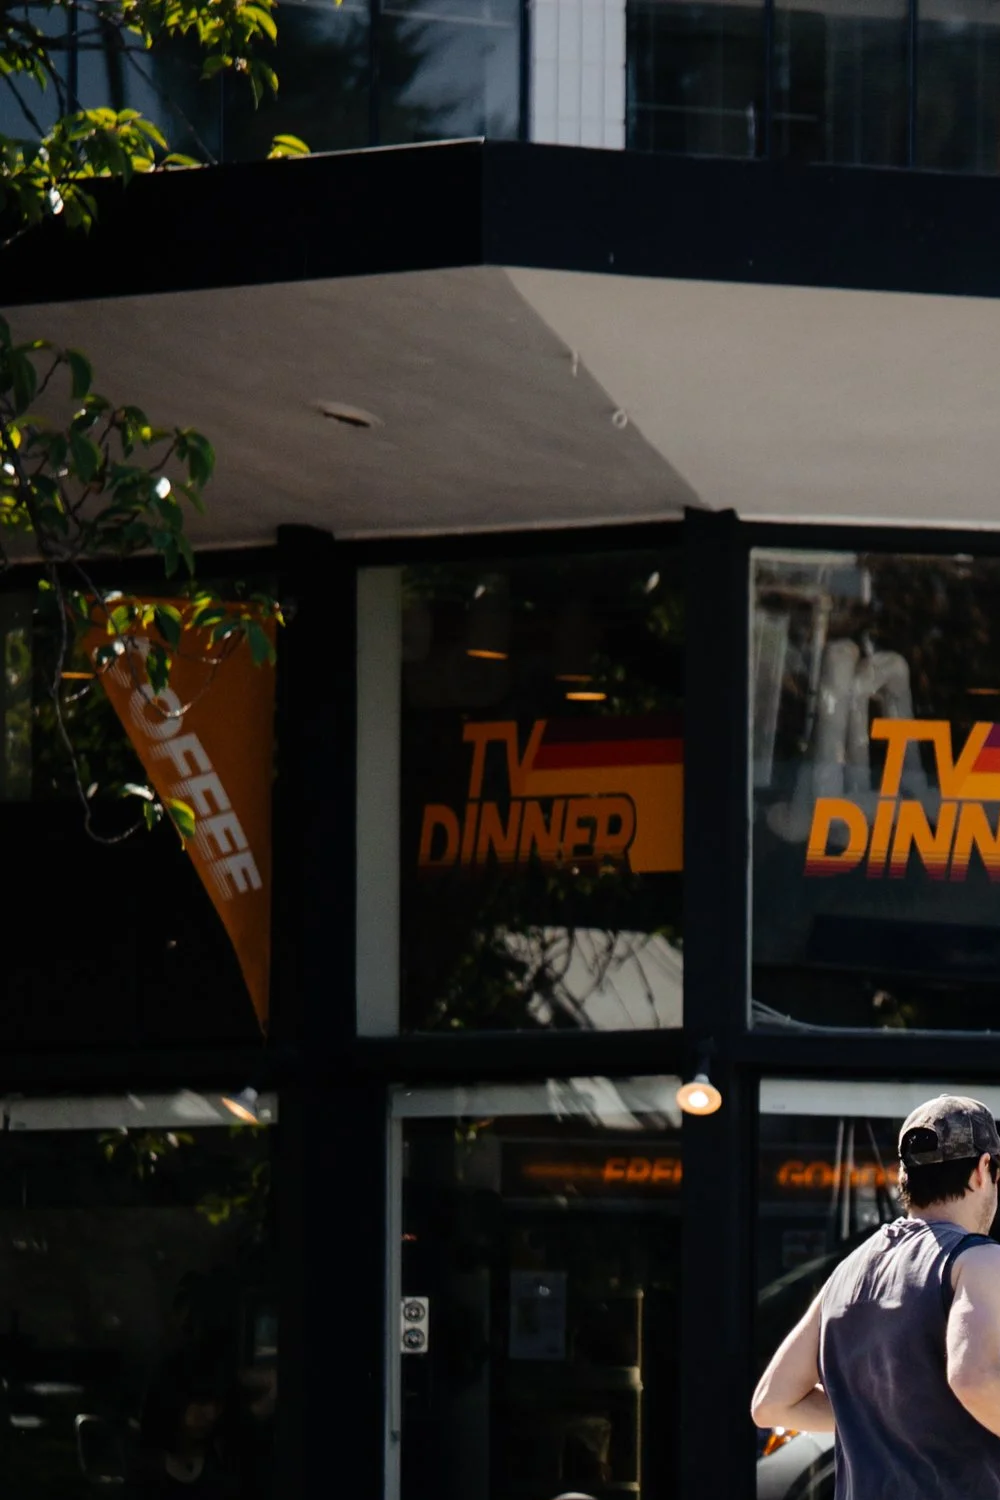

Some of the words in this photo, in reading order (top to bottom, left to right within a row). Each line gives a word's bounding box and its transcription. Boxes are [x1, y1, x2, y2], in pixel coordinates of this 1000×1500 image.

[462, 719, 547, 798] TV
[872, 717, 995, 798] TV
[418, 798, 636, 870] DINNER
